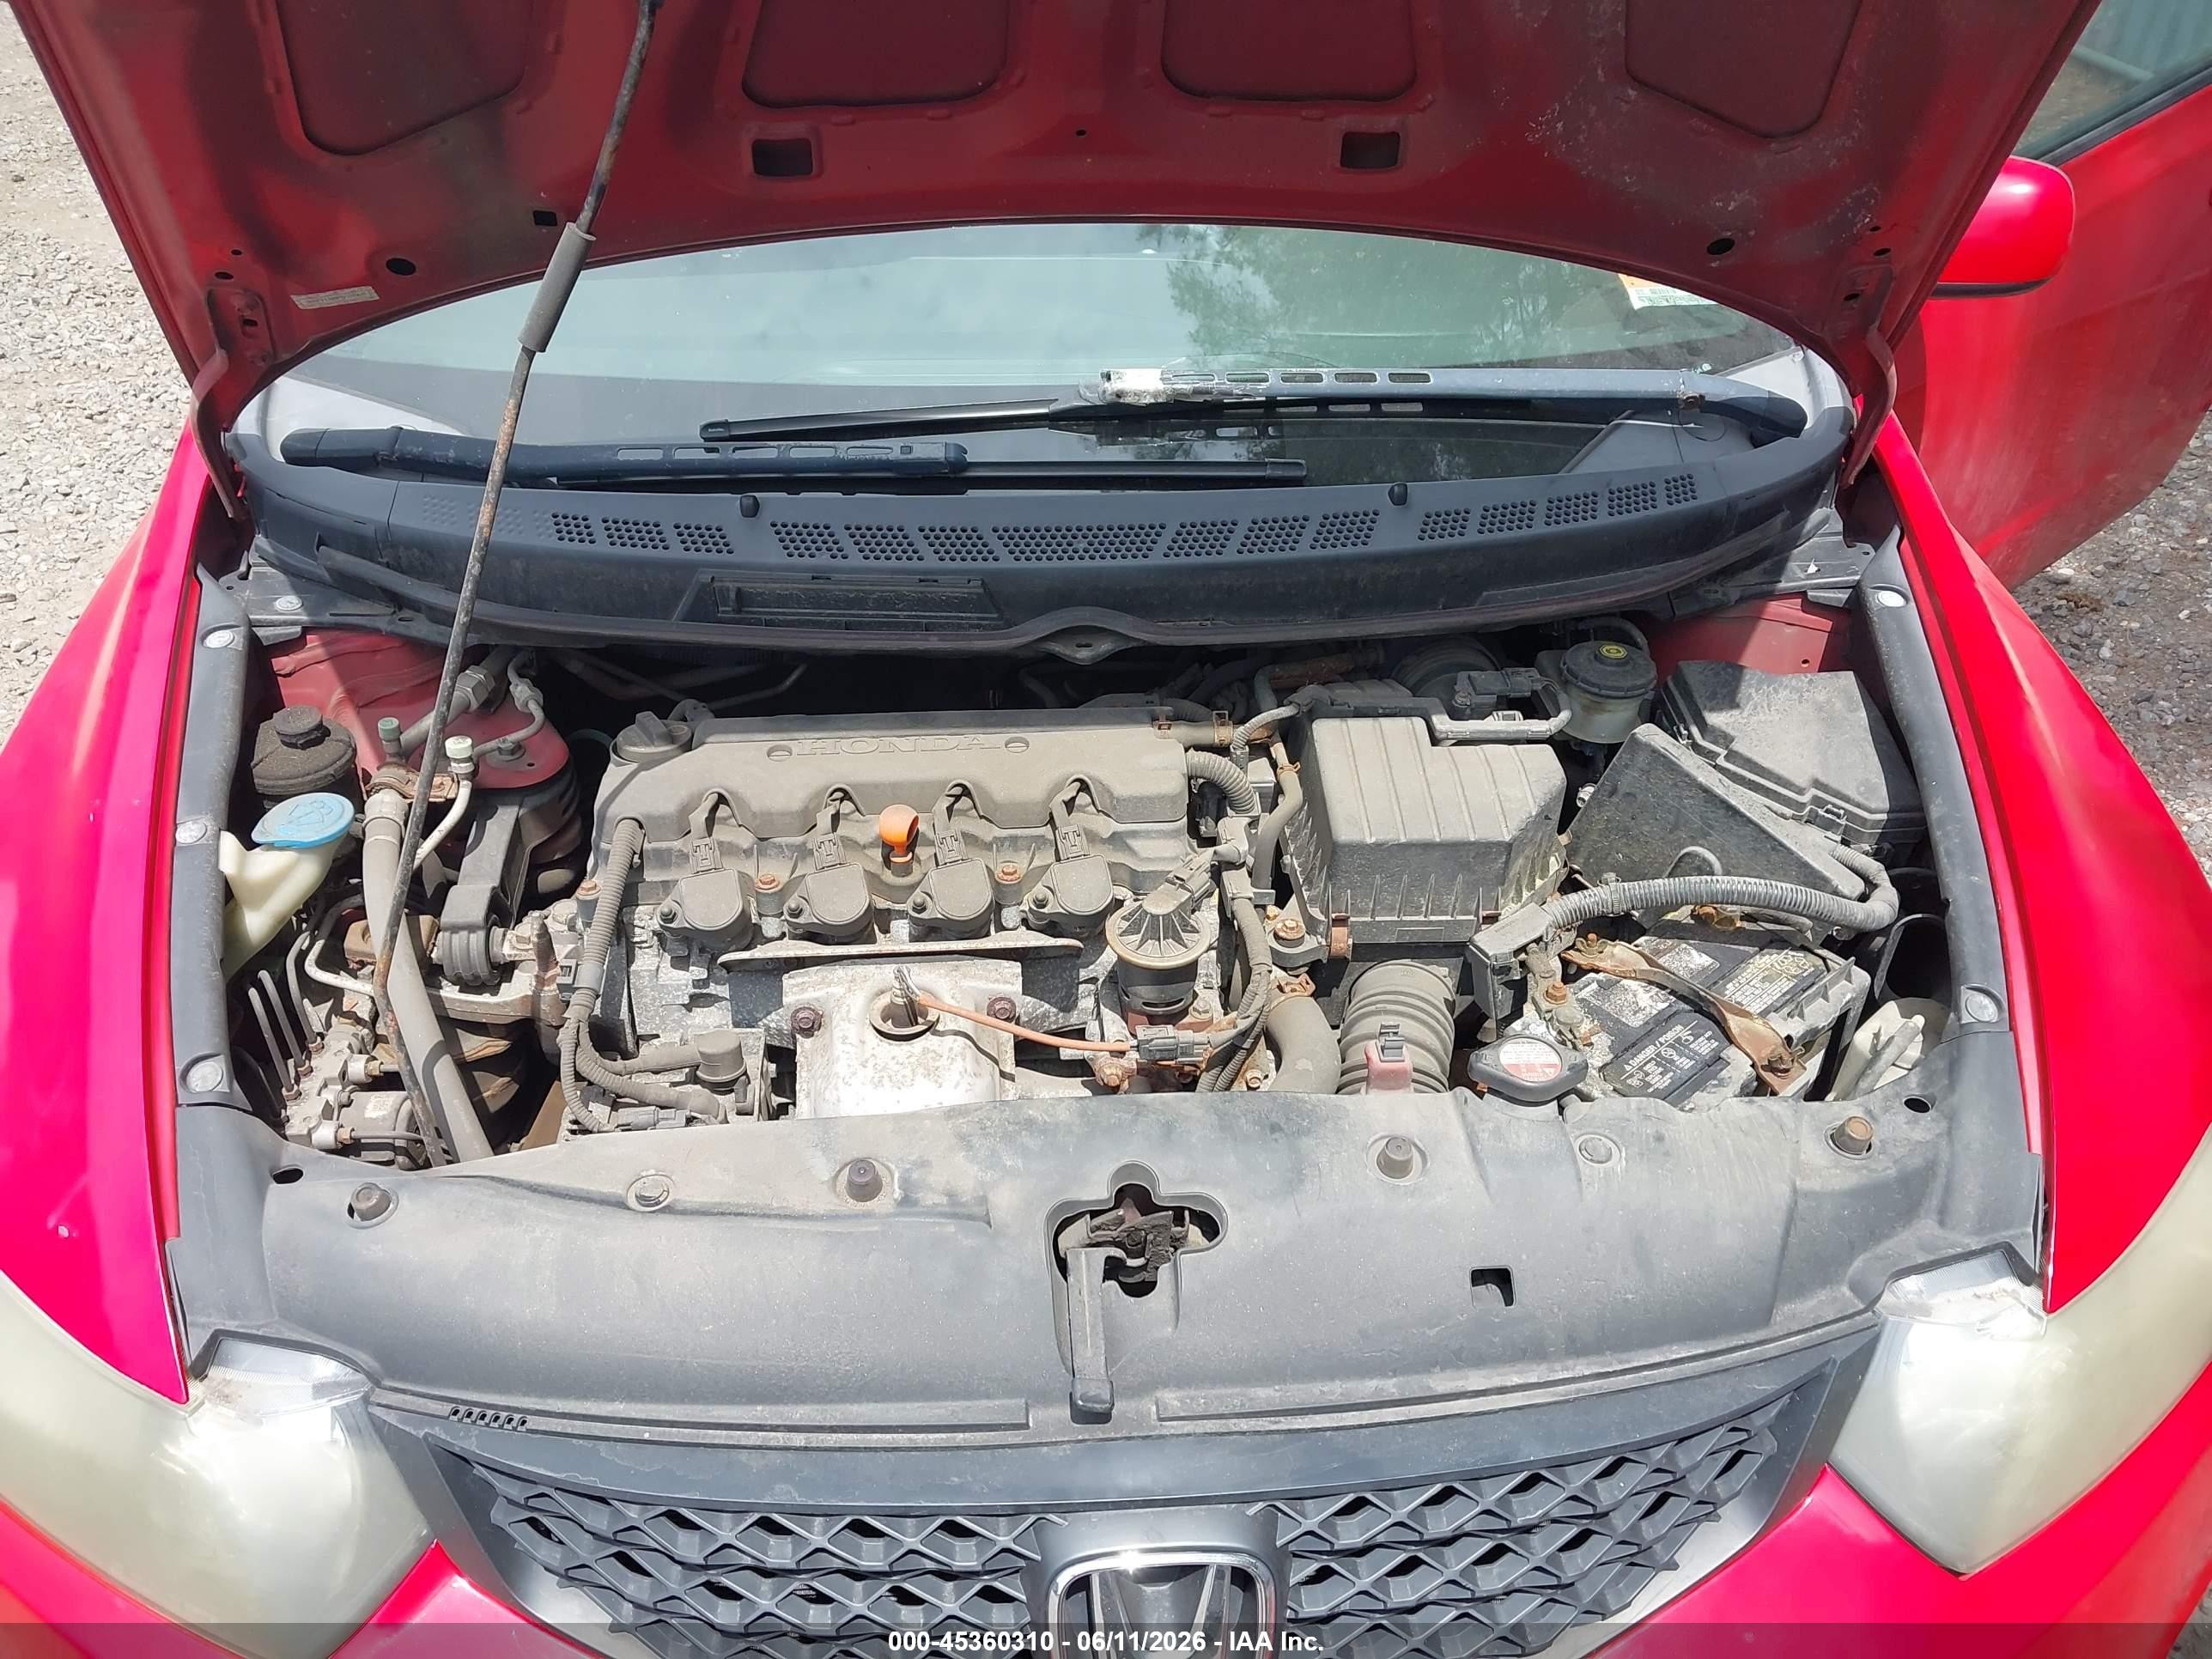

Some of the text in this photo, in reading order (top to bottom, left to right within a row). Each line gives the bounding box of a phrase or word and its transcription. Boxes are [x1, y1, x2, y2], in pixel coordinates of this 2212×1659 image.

[796, 736, 1001, 756] HONDA
[1628, 1043, 1657, 1066] DANGER
[1659, 1024, 1685, 1044] POISON
